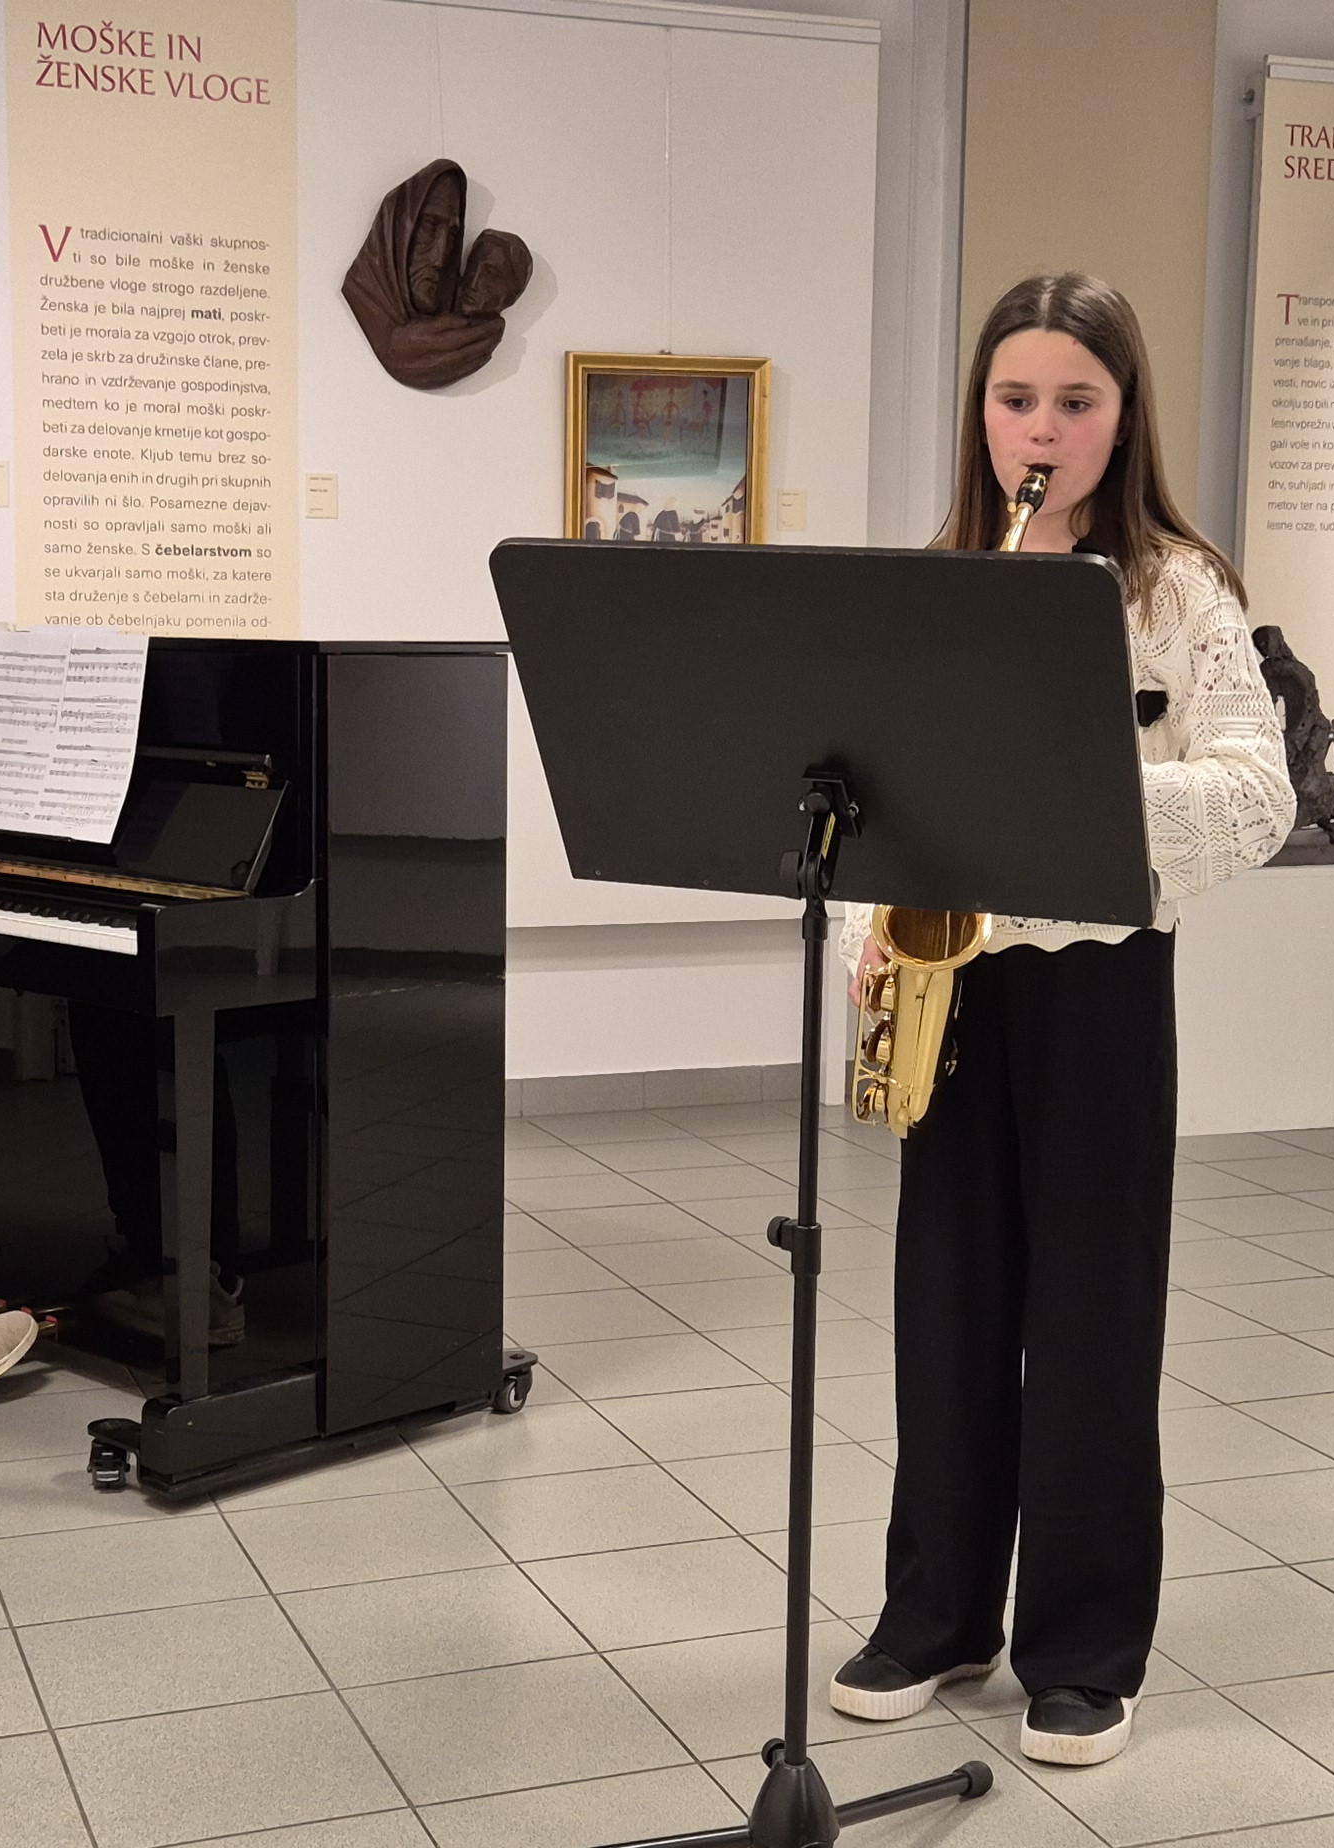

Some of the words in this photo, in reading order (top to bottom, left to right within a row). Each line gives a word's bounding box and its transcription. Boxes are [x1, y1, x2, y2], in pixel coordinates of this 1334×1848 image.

[37, 20, 156, 58] MOŠKE
[166, 34, 202, 62] IN
[35, 54, 156, 96] ŽENSKE
[164, 70, 271, 105] VLOGE
[38, 224, 73, 263] V
[80, 226, 163, 244] tradicionalni
[170, 232, 204, 246] vaški
[210, 234, 271, 252] skupnos-
[72, 249, 82, 263] ti
[90, 254, 107, 265] so
[116, 252, 141, 267] bile
[149, 255, 195, 270] moške
[202, 257, 216, 271] in
[223, 259, 271, 274] ženske
[39, 273, 105, 289] družbene
[110, 277, 147, 294] vloge
[151, 279, 195, 297] strogo
[200, 283, 271, 300] razdeljene.
[40, 296, 89, 313] Ženska
[93, 300, 107, 316] je
[111, 301, 135, 315] bila
[140, 303, 186, 321] najprej
[191, 306, 225, 321] mati,
[230, 308, 271, 323] poskr-
[40, 322, 66, 336] beti
[69, 323, 82, 340] je
[85, 326, 131, 340] morala
[135, 330, 150, 341] za
[153, 329, 196, 345] vzgojo
[199, 330, 236, 346] otrok,
[238, 336, 271, 348] prev-
[41, 347, 68, 361] zela
[70, 348, 84, 365] je
[86, 349, 115, 363] skrb
[118, 354, 134, 364] za
[136, 351, 200, 367] družinske
[203, 354, 243, 371] člane,
[245, 360, 271, 373] pre-
[42, 371, 80, 386] hrano
[85, 373, 97, 387] in
[101, 374, 177, 393] vzdrževanje
[180, 379, 271, 396] gospodinjstva,
[42, 396, 99, 411] medtem
[104, 398, 120, 412] ko
[125, 399, 138, 415] je
[143, 401, 181, 414] moral
[187, 402, 225, 416] moški
[231, 404, 271, 419] poskr-
[43, 419, 68, 434] beti
[70, 424, 85, 434] za
[88, 421, 152, 439] delovanje
[154, 424, 202, 441] kmetije
[205, 425, 224, 439] kot
[226, 430, 271, 444] gospo-
[42, 444, 88, 459] darske
[93, 446, 135, 460] enote.
[140, 447, 174, 464] Kljub
[179, 449, 213, 463] temu
[218, 450, 246, 464] brez
[251, 455, 271, 465] so-
[43, 468, 108, 486] delovanja
[110, 470, 139, 484] enih
[142, 471, 154, 484] in
[156, 471, 199, 488] drugih
[201, 472, 218, 489] pri
[220, 473, 272, 490] skupnih
[43, 493, 100, 509] opravilih
[105, 494, 118, 508] ni
[122, 495, 144, 508] šlo.
[150, 495, 228, 511] Posamezne
[232, 498, 272, 514] dejav-
[44, 517, 78, 530] nosti
[83, 521, 100, 531] so
[105, 518, 165, 535] opravljali
[170, 523, 208, 533] samo
[213, 520, 252, 534] moški
[256, 521, 272, 535] ali
[44, 544, 82, 554] samo
[86, 541, 138, 555] ženske.
[141, 542, 151, 556] S
[155, 542, 252, 558] čebelarstvom
[256, 548, 272, 558] so
[44, 568, 61, 578] se
[65, 565, 121, 582] ukvarjali
[125, 569, 163, 580] samo
[167, 567, 209, 582] moški,
[213, 571, 228, 581] za
[232, 568, 272, 582] katere
[45, 588, 65, 602] sta
[69, 588, 129, 605] druženje
[132, 593, 140, 603] s
[144, 590, 205, 604] čebelami
[209, 591, 220, 604] in
[224, 591, 272, 605] zadrže-
[86, 613, 103, 626] ob
[108, 613, 181, 630] čebelnjaku
[186, 614, 247, 630] pomenila
[251, 614, 272, 628] od-
